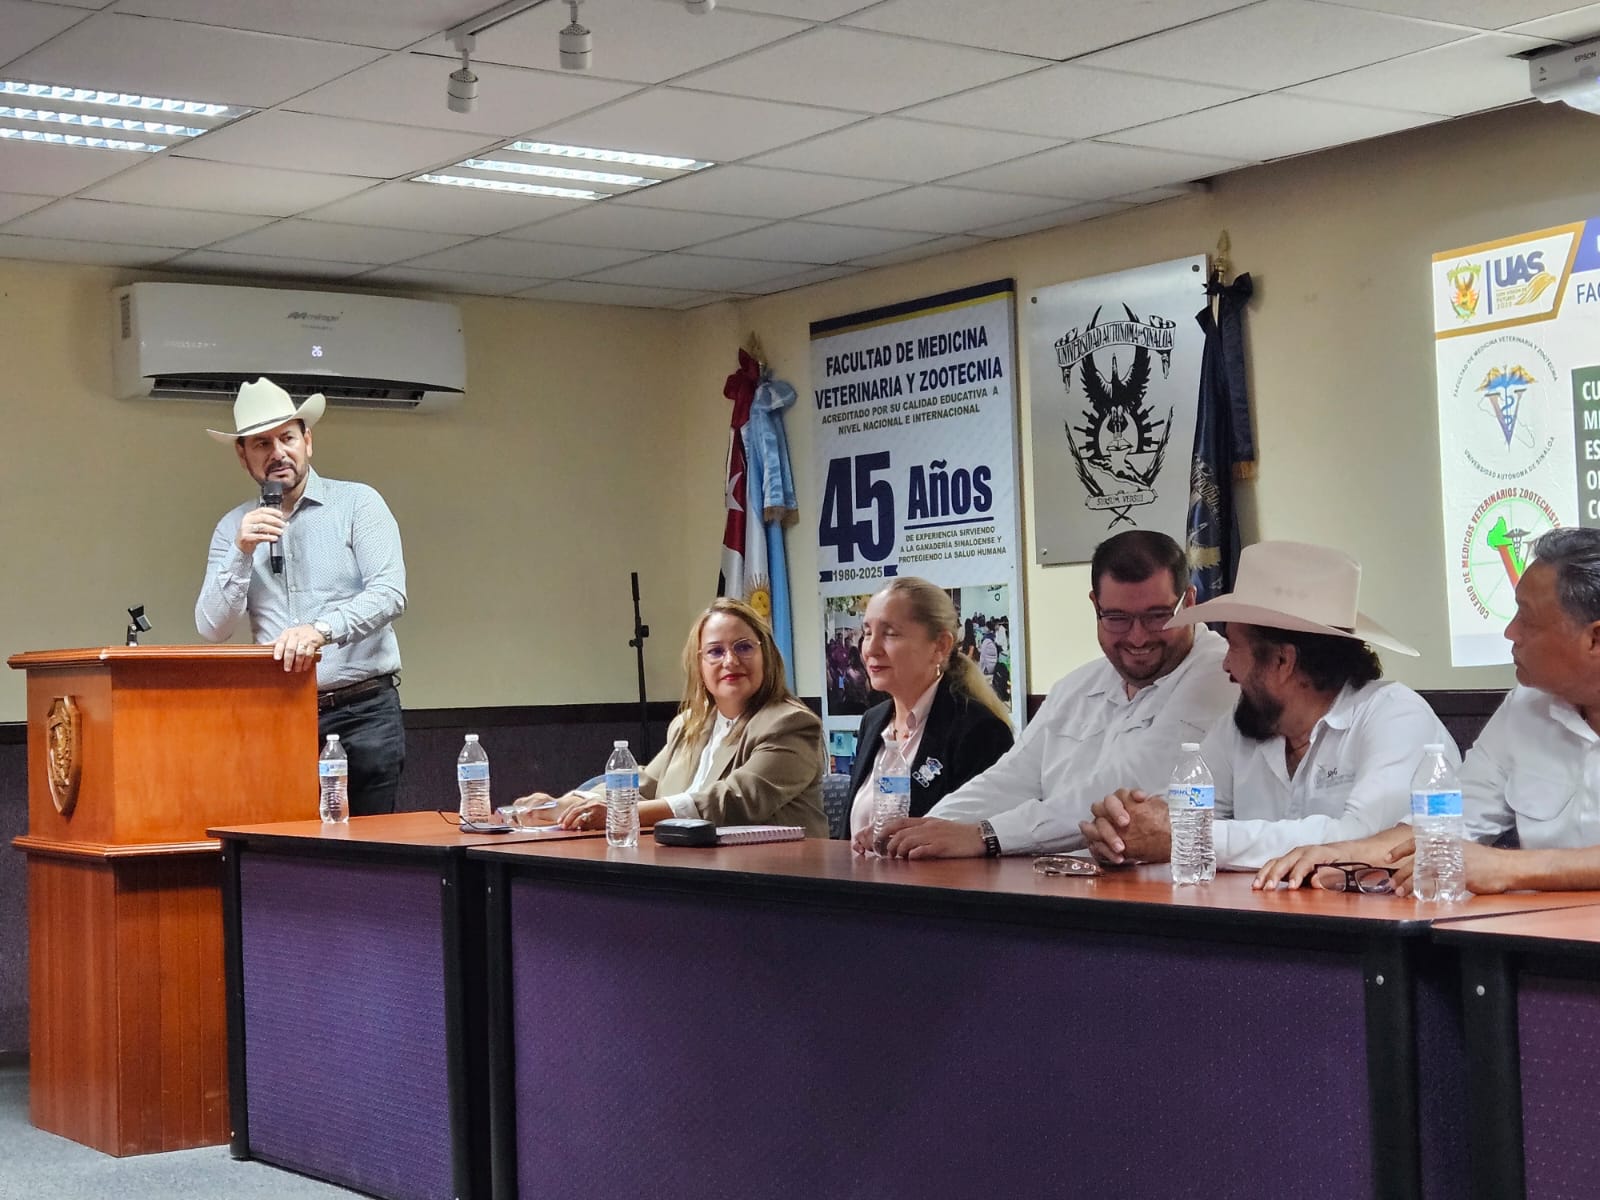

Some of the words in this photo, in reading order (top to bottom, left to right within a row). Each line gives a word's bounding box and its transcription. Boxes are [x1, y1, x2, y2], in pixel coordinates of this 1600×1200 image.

[1494, 250, 1545, 288] UAS
[1576, 281, 1600, 305] FA
[826, 344, 892, 377] FACULTAD
[896, 340, 914, 365] DE
[917, 325, 988, 360] MEDICINA
[814, 374, 903, 410] VETERINARIA
[906, 372, 915, 394] Y
[919, 356, 1003, 392] ZOOTECNIA
[821, 408, 870, 425] ACREDITADO
[872, 405, 888, 416] POR
[890, 402, 901, 413] SU
[902, 396, 938, 411] CALIDAD
[940, 387, 988, 405] EDUCATIVA
[992, 385, 999, 396] A
[838, 423, 861, 435] NIVEL
[863, 416, 904, 432] NACIONAL
[905, 415, 911, 424] E
[912, 403, 981, 423] INTERNACIONAL
[1583, 410, 1600, 430] M
[907, 458, 993, 521] Años
[1586, 469, 1600, 491] O
[819, 450, 896, 564] 45
[1471, 487, 1518, 525] VETERINARIOS
[905, 534, 915, 543] DE
[915, 529, 958, 542] EXPERIENCIA
[959, 526, 996, 537] SIRVIENDO
[906, 543, 915, 553] LA
[954, 536, 996, 548] SINALOENSE
[1461, 524, 1475, 569] MEDICOS
[898, 552, 943, 564] PROTEGIENDO
[944, 550, 953, 560] LA
[954, 548, 976, 559] SALUD
[977, 546, 1007, 557] HUMANA
[832, 566, 883, 581] 1980-2025
[1462, 571, 1471, 584] DE
[1466, 585, 1490, 620] COLEGIO
